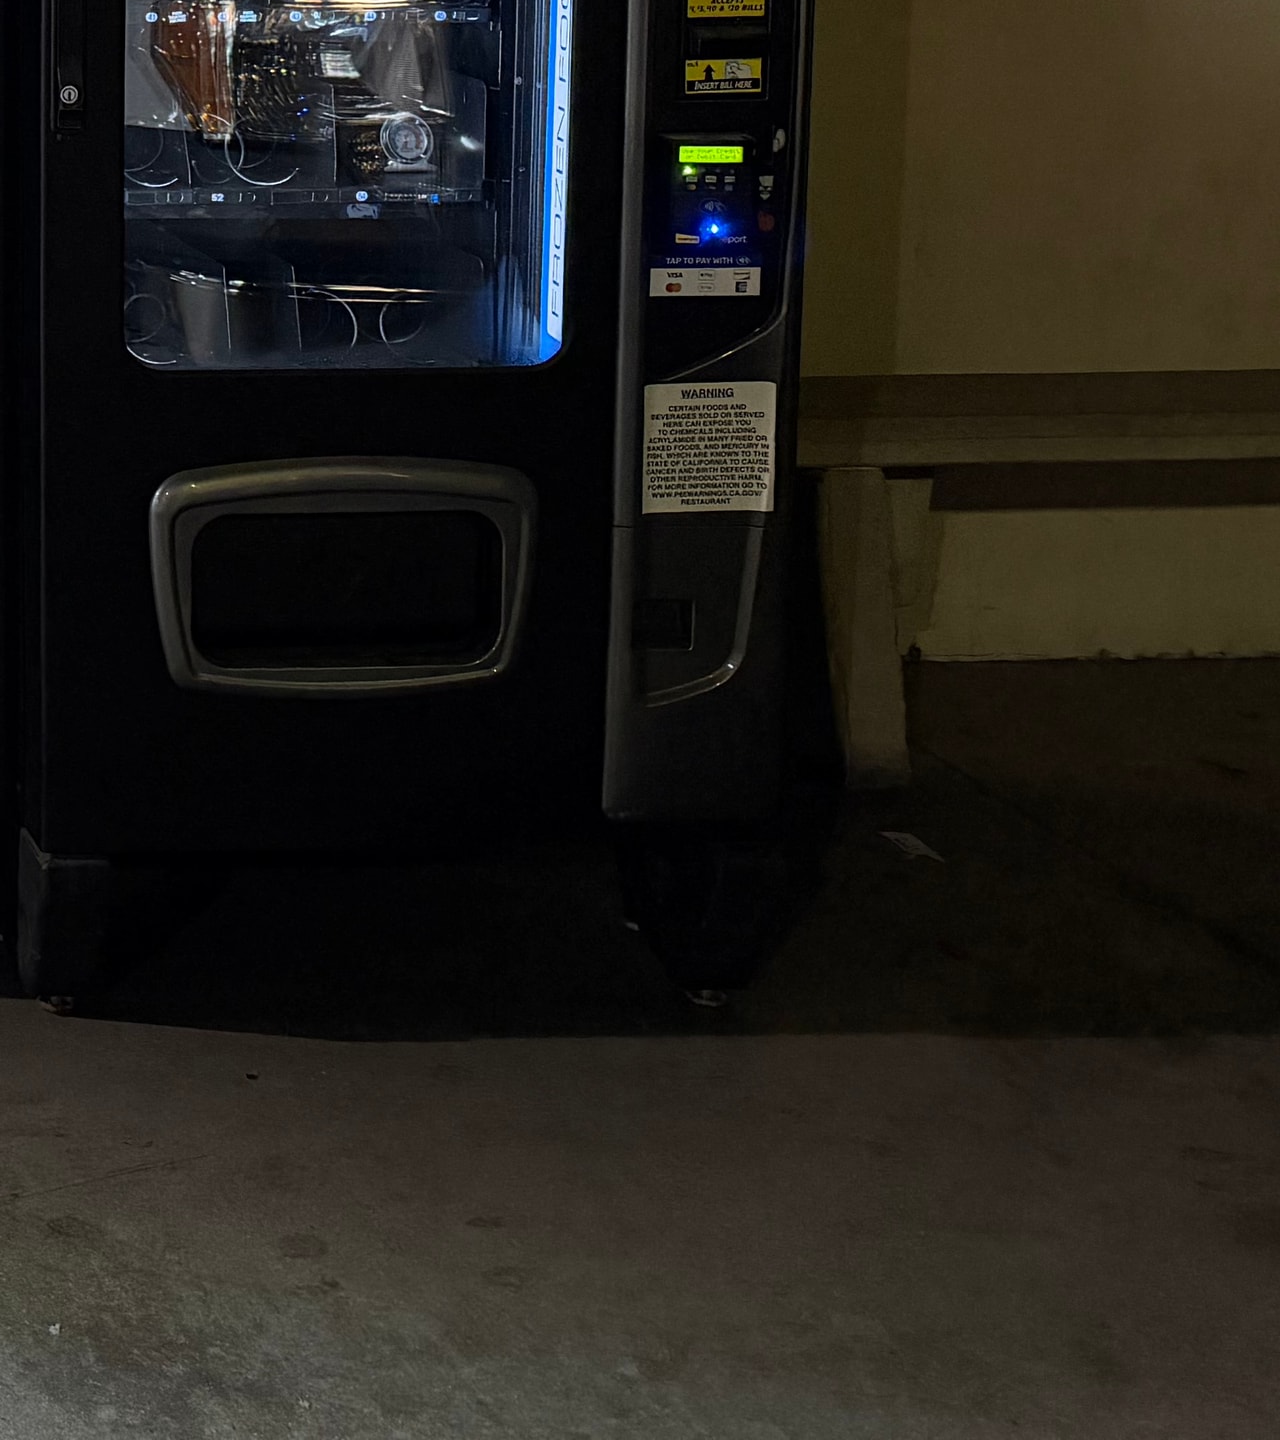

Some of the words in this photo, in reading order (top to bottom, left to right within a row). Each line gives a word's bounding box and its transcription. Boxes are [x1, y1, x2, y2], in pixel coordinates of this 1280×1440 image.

[694, 81, 718, 91] INSERT
[720, 81, 732, 89] BILL
[734, 80, 752, 89] HERE
[550, 105, 566, 319] FROZEN
[680, 388, 734, 399] WARNING
